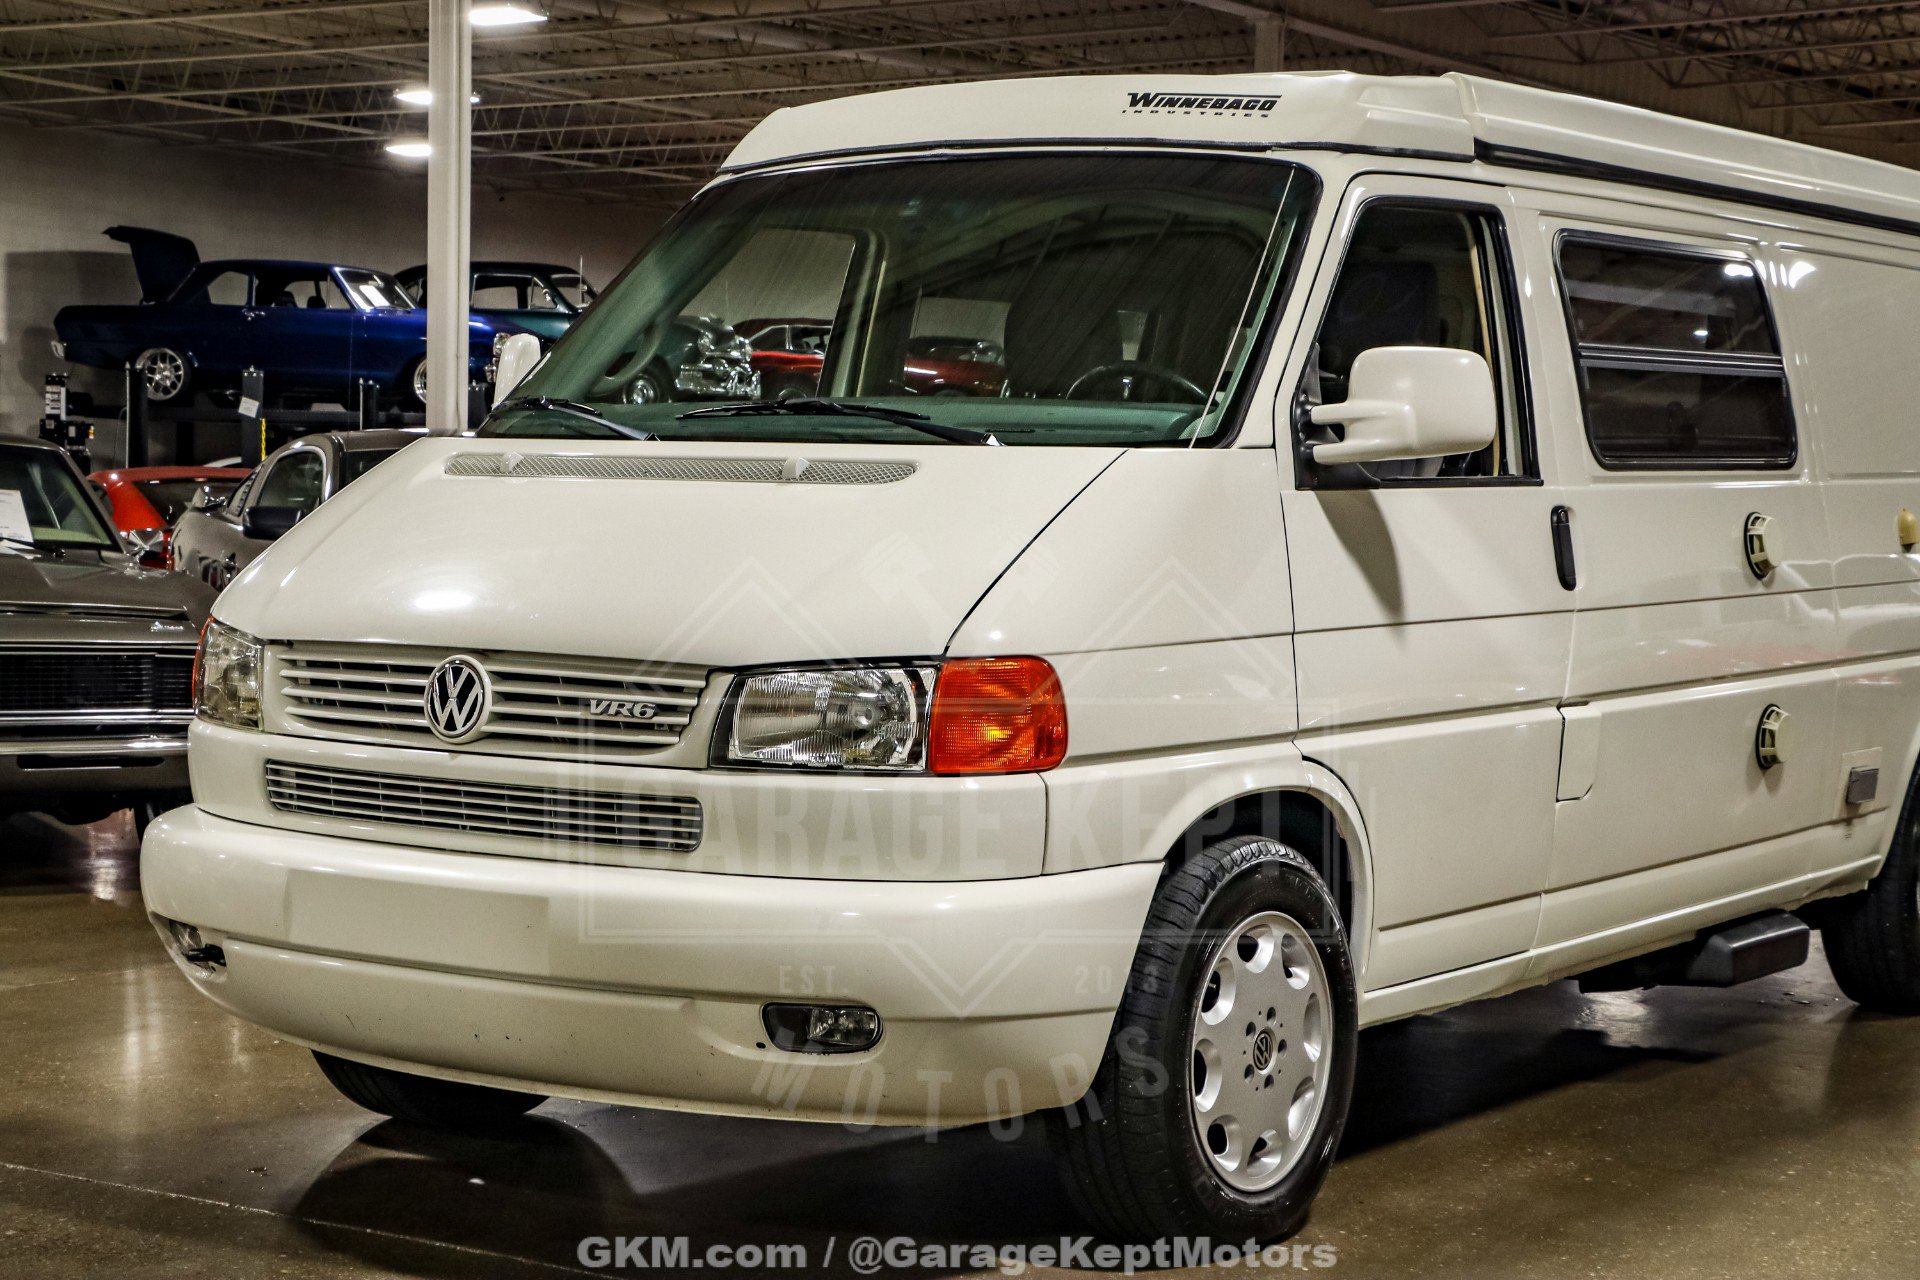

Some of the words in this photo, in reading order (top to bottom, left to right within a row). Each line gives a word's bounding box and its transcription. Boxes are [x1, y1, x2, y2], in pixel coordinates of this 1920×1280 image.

[1122, 109, 1269, 118] INDUSTRIES
[427, 660, 485, 738] VW
[589, 698, 656, 719] VR6
